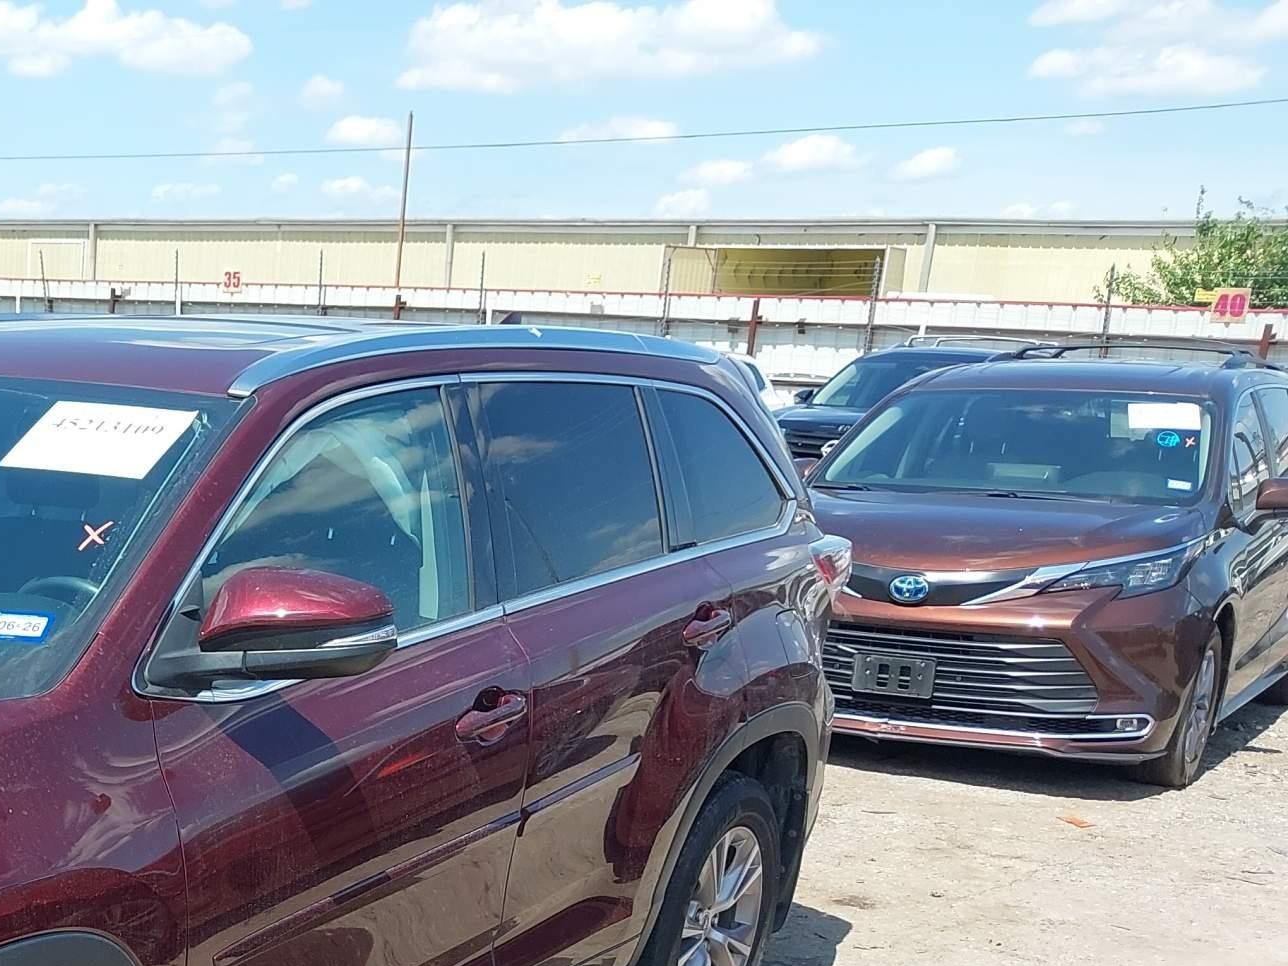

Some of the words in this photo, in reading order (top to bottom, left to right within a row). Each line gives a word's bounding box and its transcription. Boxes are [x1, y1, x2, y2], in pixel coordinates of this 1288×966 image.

[223, 271, 241, 288] 35
[1213, 293, 1246, 317] 40
[51, 418, 166, 435] 45213109
